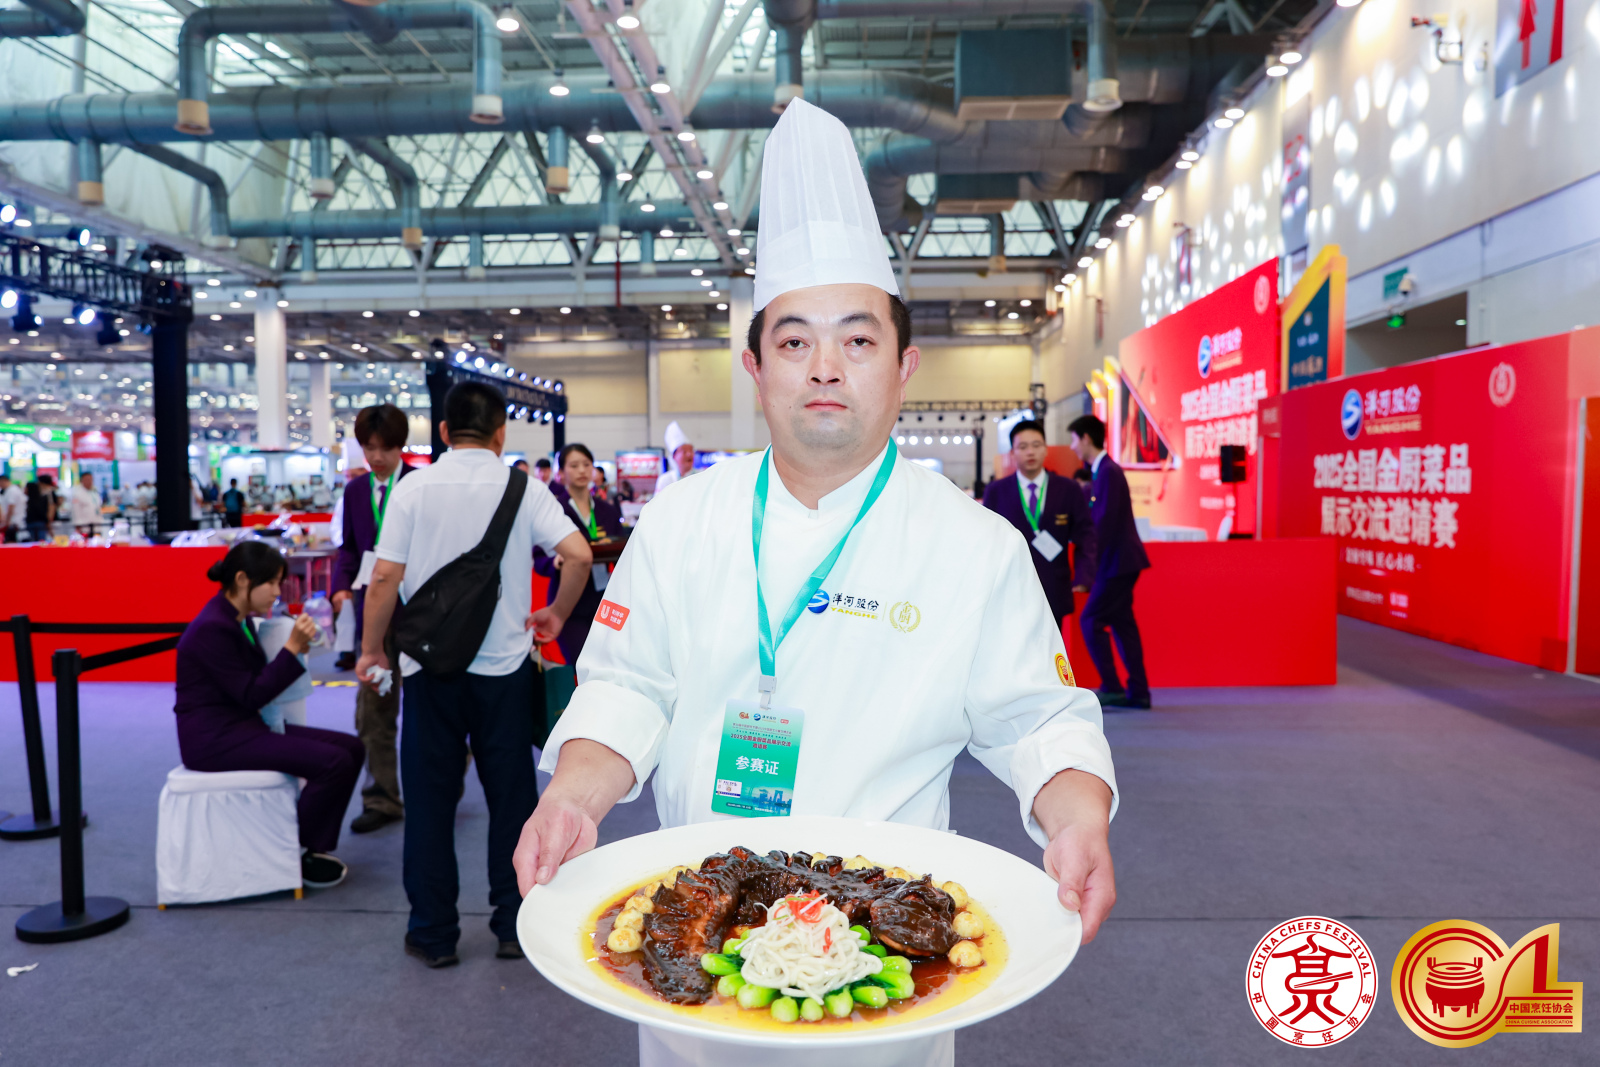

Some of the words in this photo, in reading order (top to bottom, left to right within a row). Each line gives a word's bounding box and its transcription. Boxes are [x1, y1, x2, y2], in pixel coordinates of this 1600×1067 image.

[1313, 442, 1473, 494] 2025全国金厨菜品
[1320, 495, 1460, 549] 展示交流邀请赛
[832, 593, 880, 611] 洋河股份
[830, 606, 879, 620] YANGHE
[735, 755, 780, 776] 参赛证
